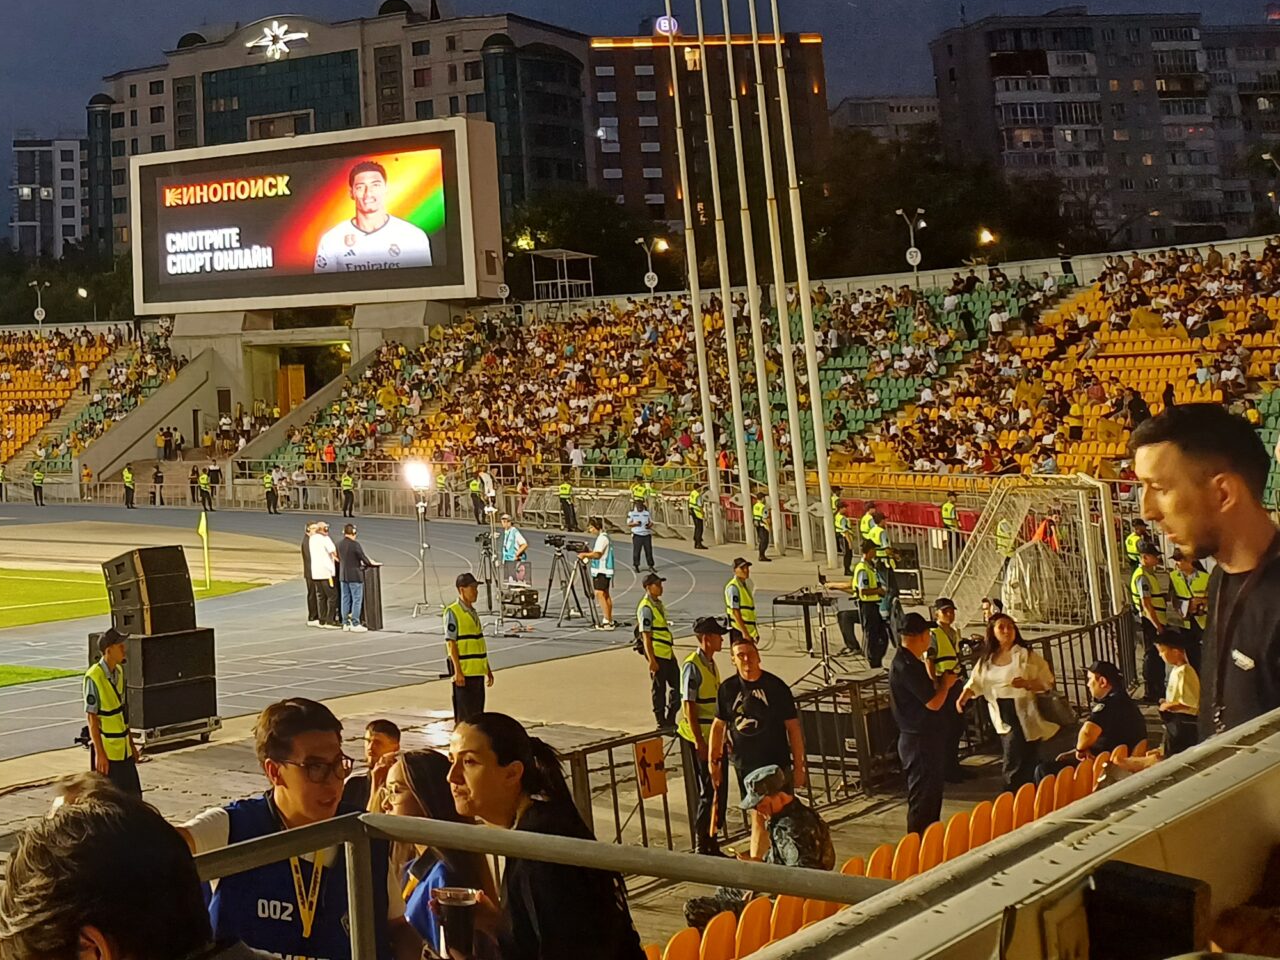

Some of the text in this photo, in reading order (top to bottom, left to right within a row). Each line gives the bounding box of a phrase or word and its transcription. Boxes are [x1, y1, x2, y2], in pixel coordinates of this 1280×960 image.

[165, 175, 290, 207] КИНОПОИСК
[165, 227, 240, 253] СМОТРИТЕ
[166, 244, 273, 275] СПОРТ ОНЛАЙН
[345, 260, 400, 272] Emirates
[257, 898, 294, 921] 002
